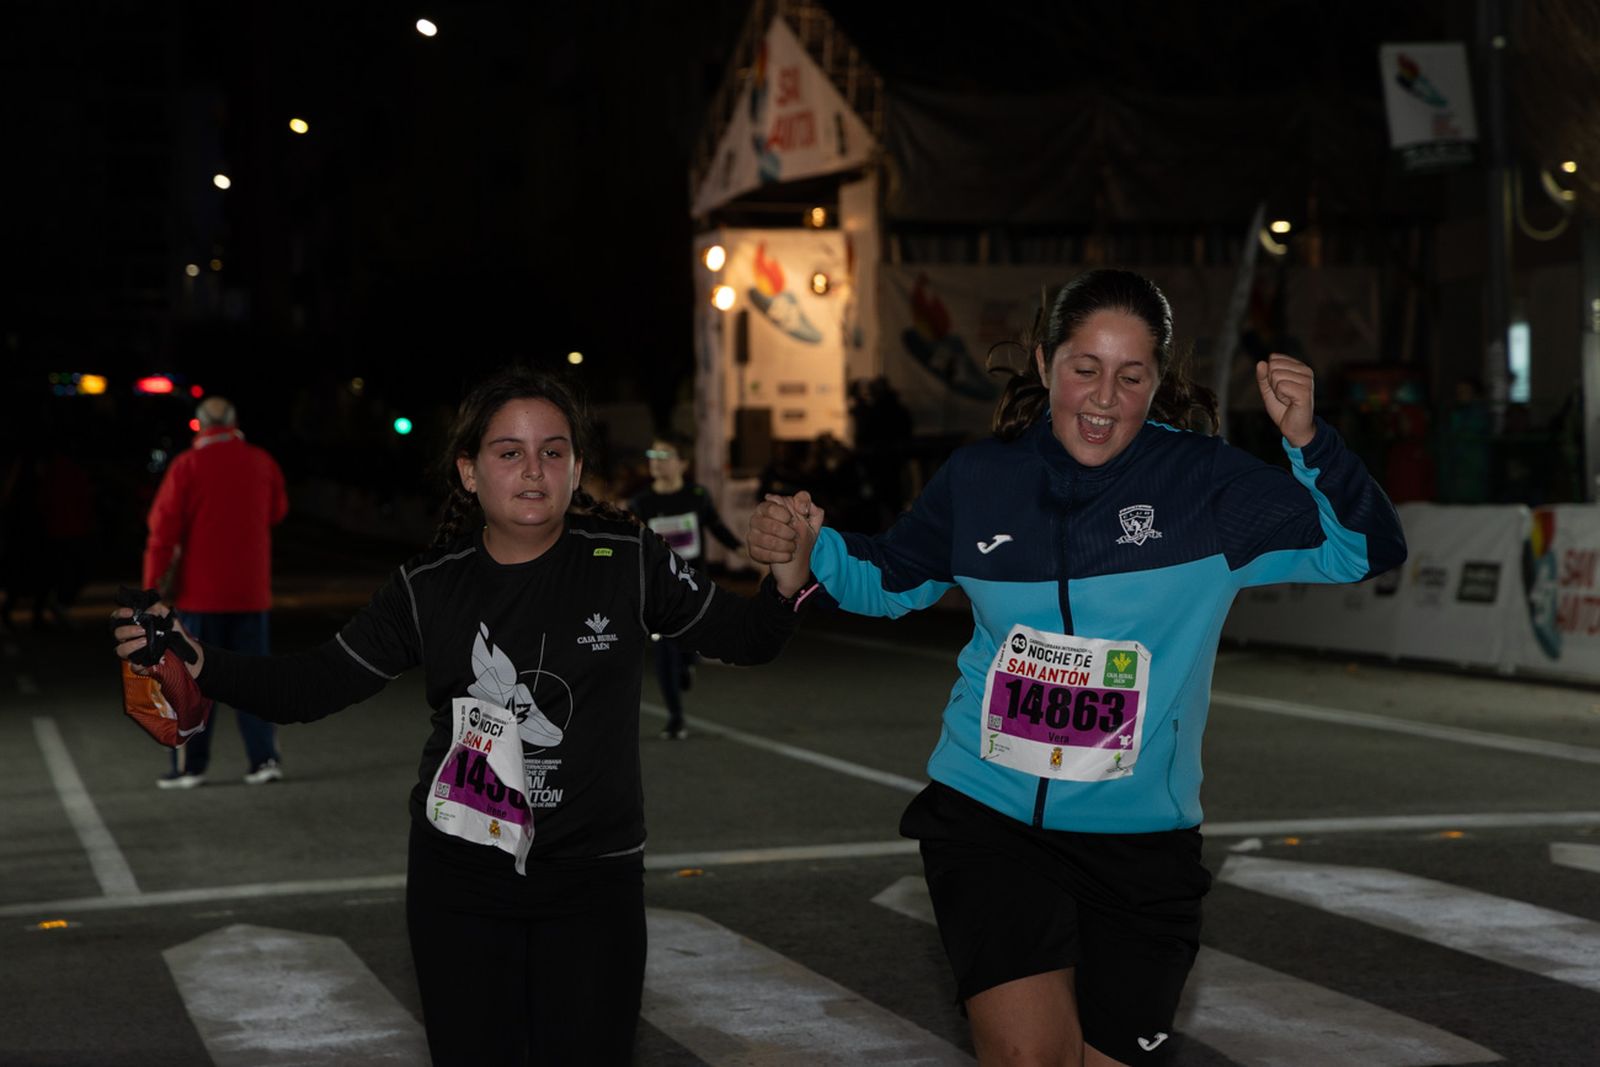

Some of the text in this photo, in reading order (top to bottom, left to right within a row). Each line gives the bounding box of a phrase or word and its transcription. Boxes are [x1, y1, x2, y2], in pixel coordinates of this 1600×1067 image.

[1011, 637, 1026, 648] 43
[1027, 644, 1072, 665] NOCHE
[1073, 653, 1093, 668] DE
[1007, 658, 1090, 686] SAN ANTÓN
[1005, 679, 1126, 733] 14863
[1048, 731, 1070, 744] Vera
